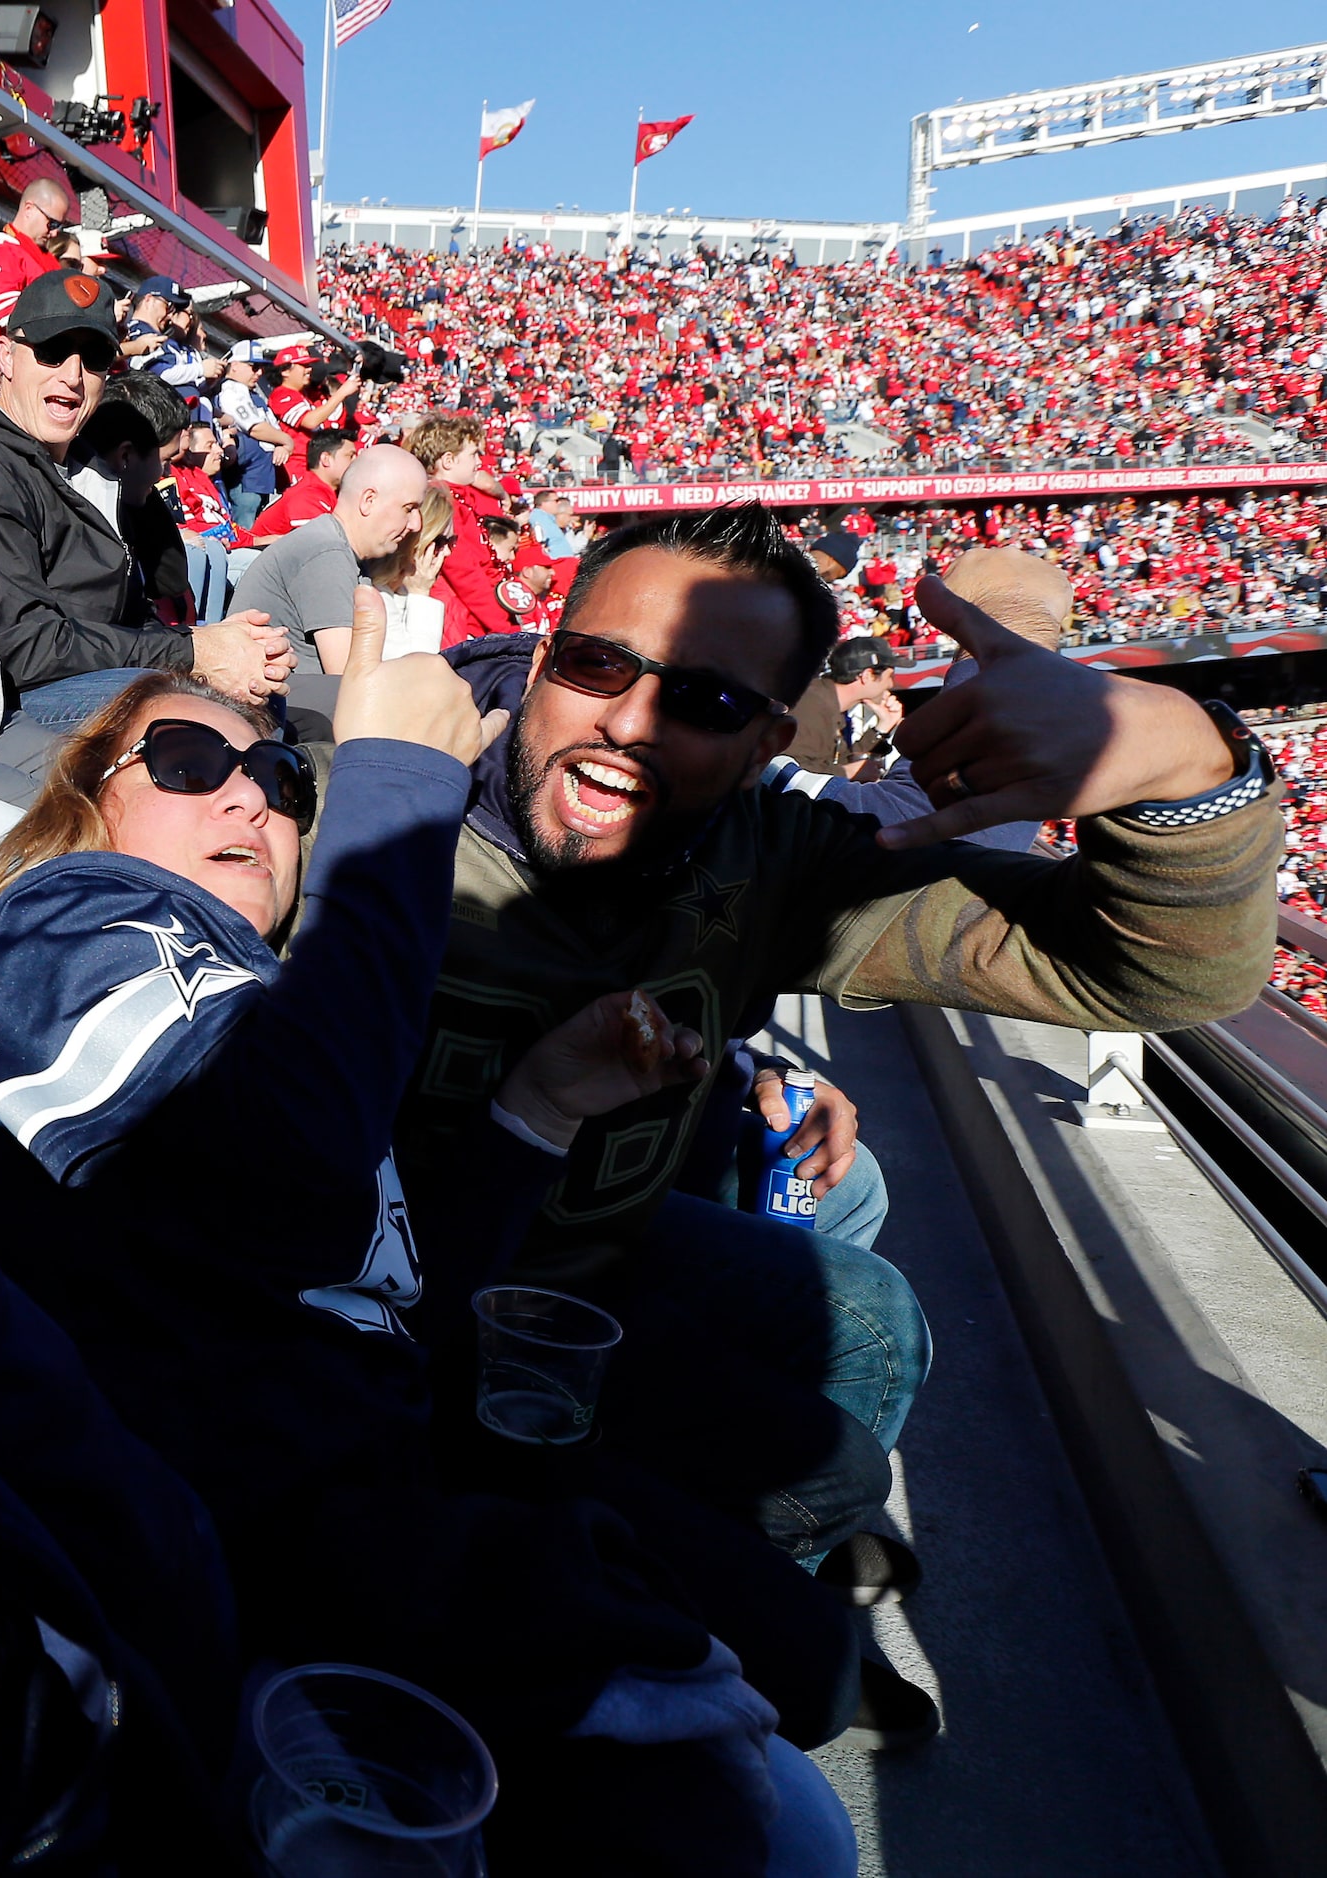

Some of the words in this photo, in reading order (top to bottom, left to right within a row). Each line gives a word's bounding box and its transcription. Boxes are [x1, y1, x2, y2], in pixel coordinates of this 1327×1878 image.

[673, 486, 714, 504] NEED
[715, 483, 810, 504] ASSISTANCE?
[818, 481, 855, 499] TEXT
[934, 478, 953, 495] TO
[954, 477, 986, 494] (573)
[986, 475, 1048, 493] 549-HELP
[505, 581, 533, 609] SF
[786, 1177, 813, 1197] BU
